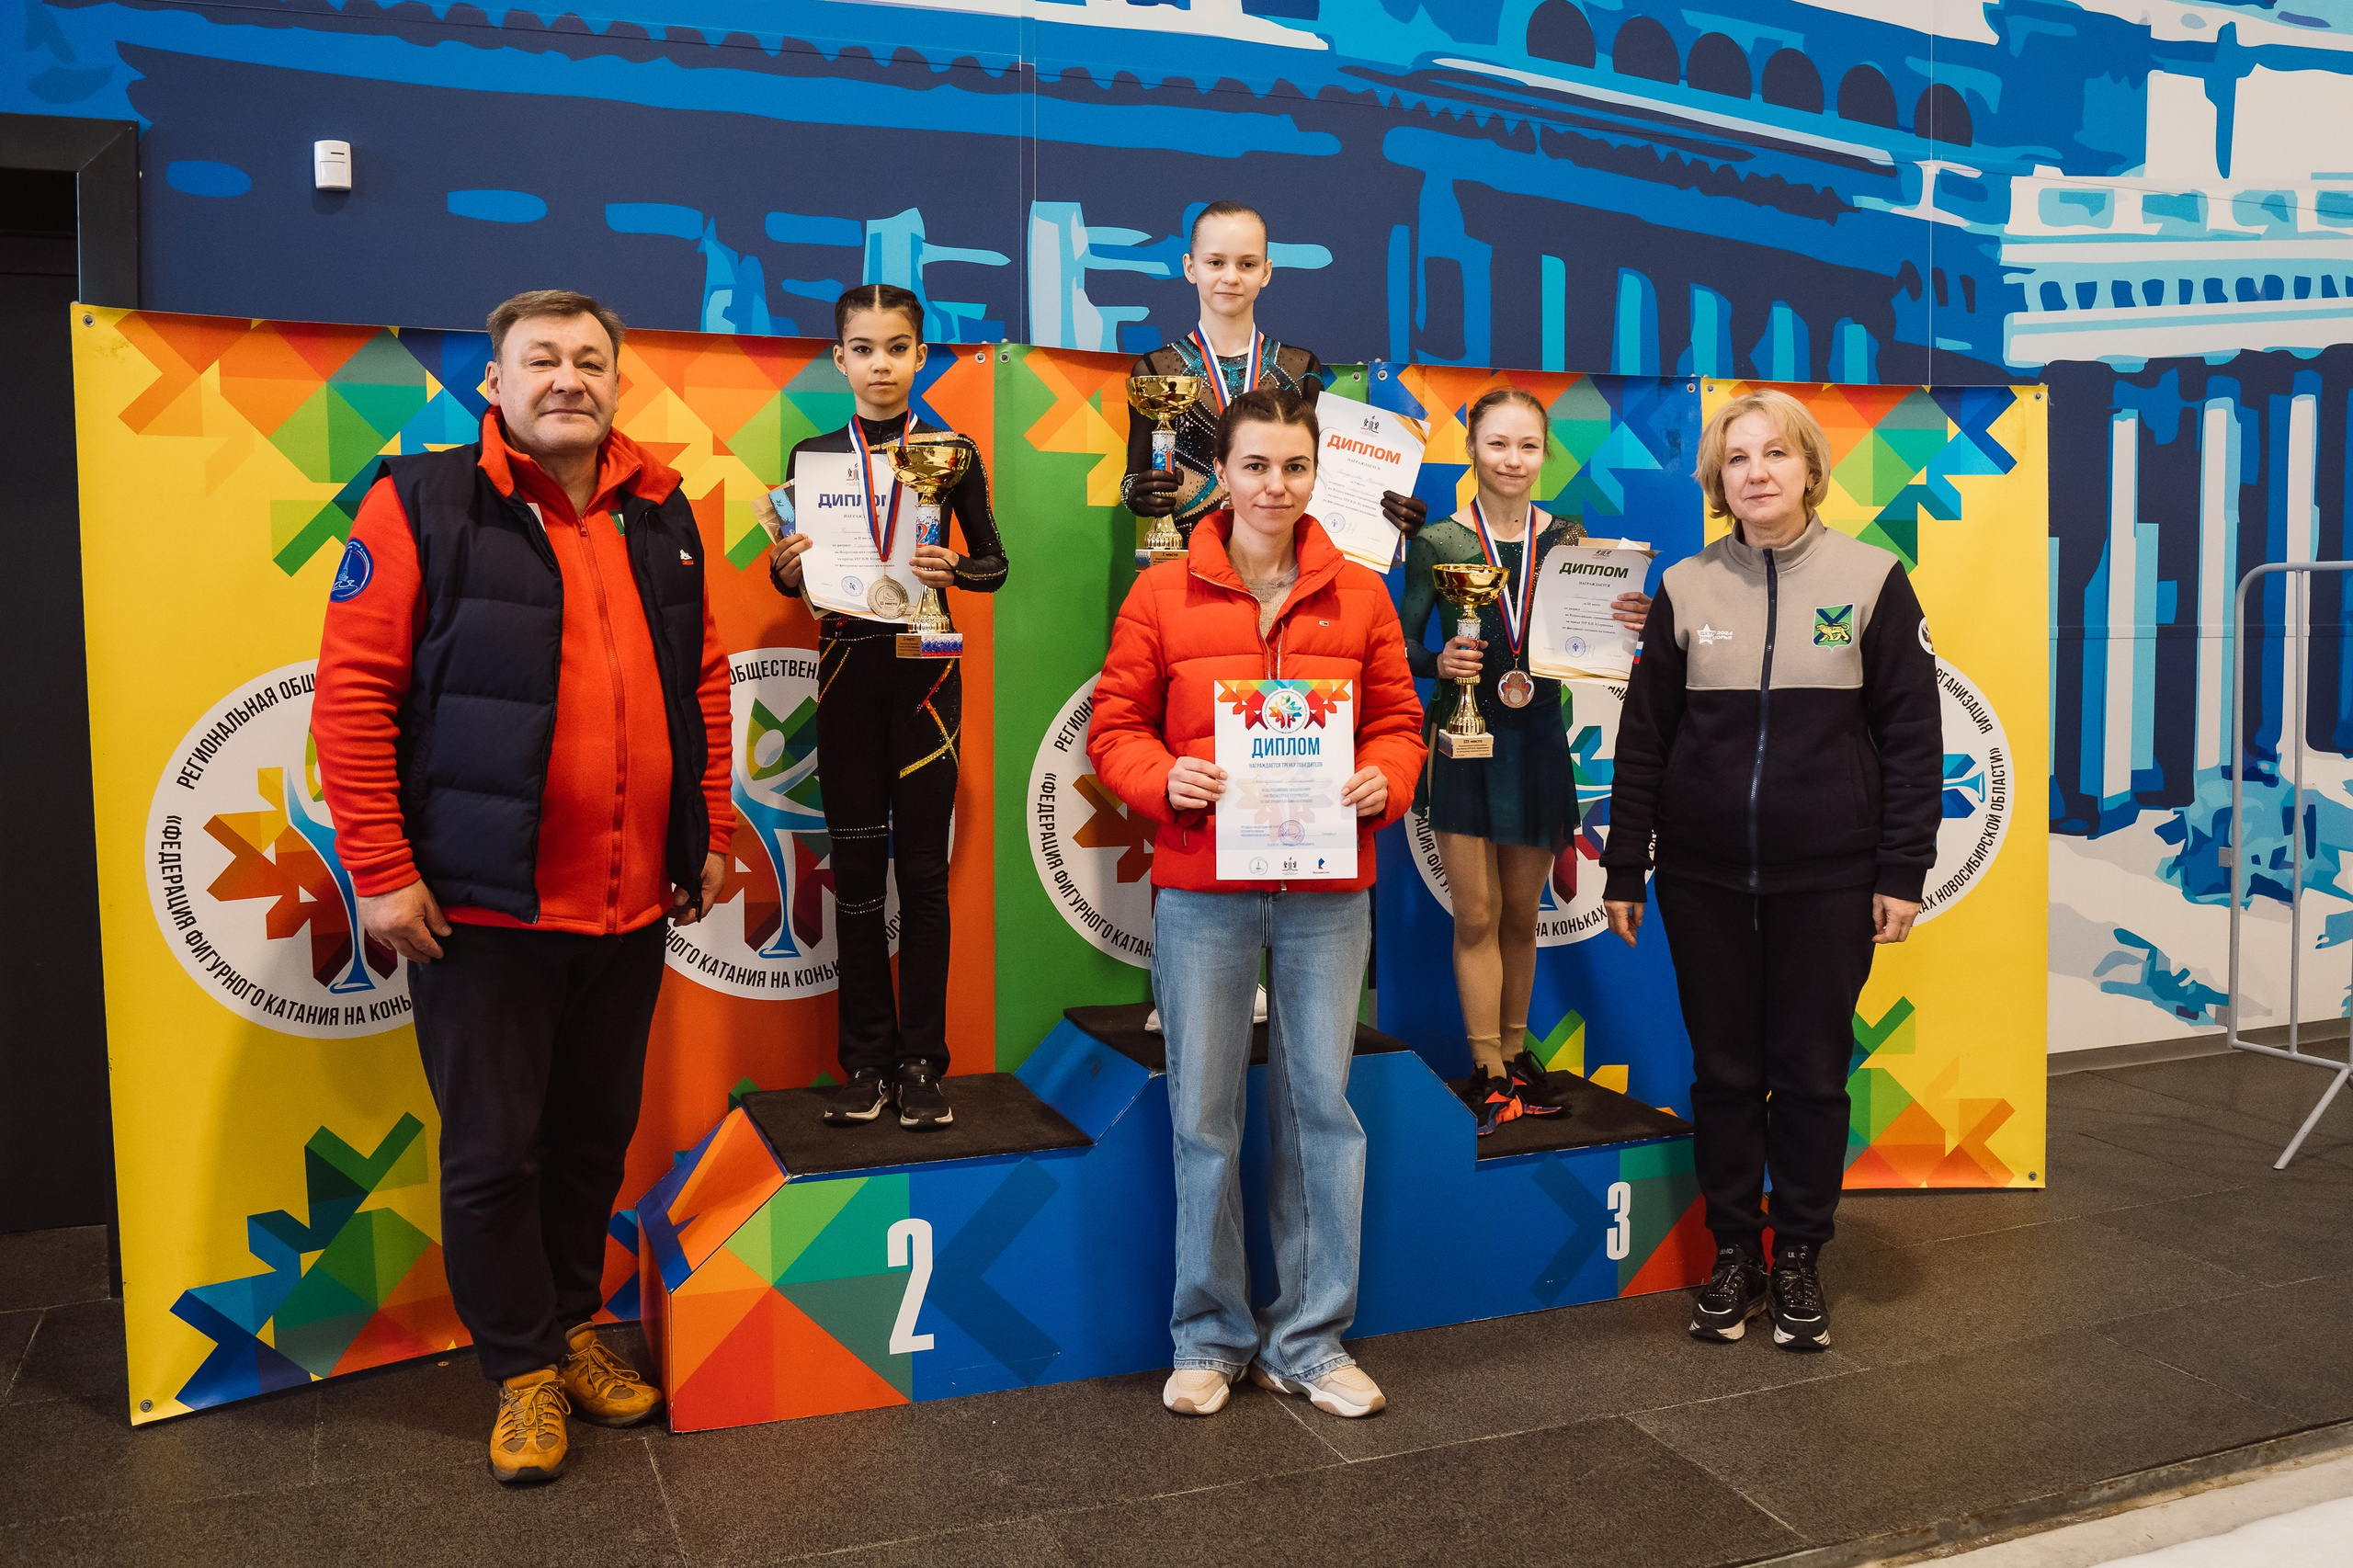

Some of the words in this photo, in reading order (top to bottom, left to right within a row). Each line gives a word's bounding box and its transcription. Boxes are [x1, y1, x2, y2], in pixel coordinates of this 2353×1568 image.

[1326, 434, 1401, 465] ДИПЛОМ
[1559, 562, 1630, 579] ДИПЛОМ
[730, 659, 819, 686] ОБЩЕСТВЕН
[176, 686, 279, 790] РЕГИОНАЛЬНАЯ
[1251, 736, 1320, 758] ДИПЛОМ
[1935, 813, 2003, 904] НОВОСИБИРСКОЙ
[1988, 746, 2006, 812] ОБЛАСТИ»
[1037, 772, 1064, 870] «ФЕДЕРАЦИЯ
[1053, 869, 1114, 939] ФИГУРНОГО
[158, 814, 197, 932] «ФЕДЕРАЦИЯ
[184, 926, 265, 1007] ФИГУРНОГО
[262, 994, 339, 1027] КАТАНИЯ
[344, 1006, 366, 1026] НА
[369, 994, 412, 1022] КОНЬ
[1552, 904, 1608, 937] КОНЬКАХ
[697, 953, 767, 988] КАТАНИЯ
[770, 971, 790, 988] НА
[1607, 1181, 1631, 1260] 3
[887, 1218, 935, 1356] 2
